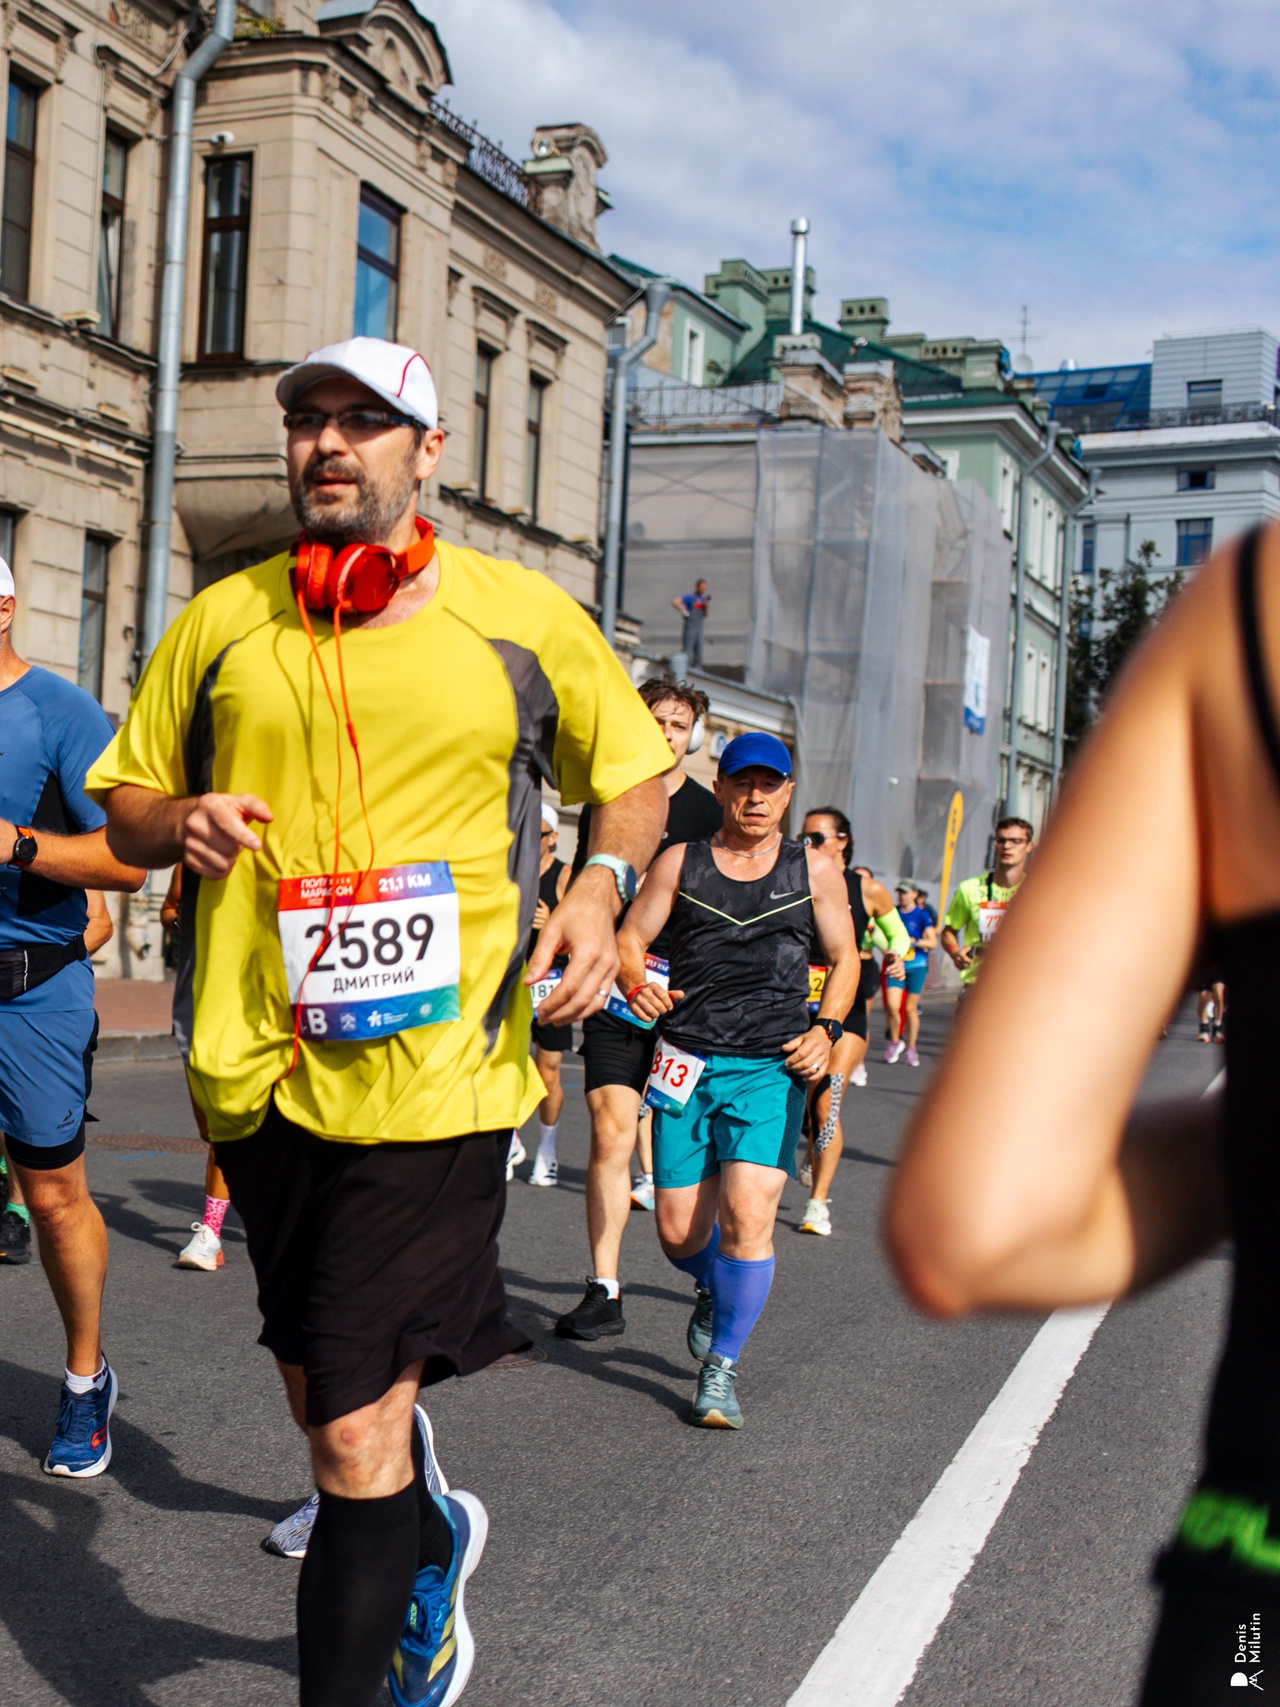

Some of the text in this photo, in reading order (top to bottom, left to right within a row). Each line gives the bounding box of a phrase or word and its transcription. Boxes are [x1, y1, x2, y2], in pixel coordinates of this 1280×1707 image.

[300, 877, 326, 889] ПОЛУ
[378, 876, 404, 893] 21,1
[304, 913, 435, 973] 2589
[333, 967, 415, 994] ДМИТРИЙ
[307, 1008, 328, 1034] B
